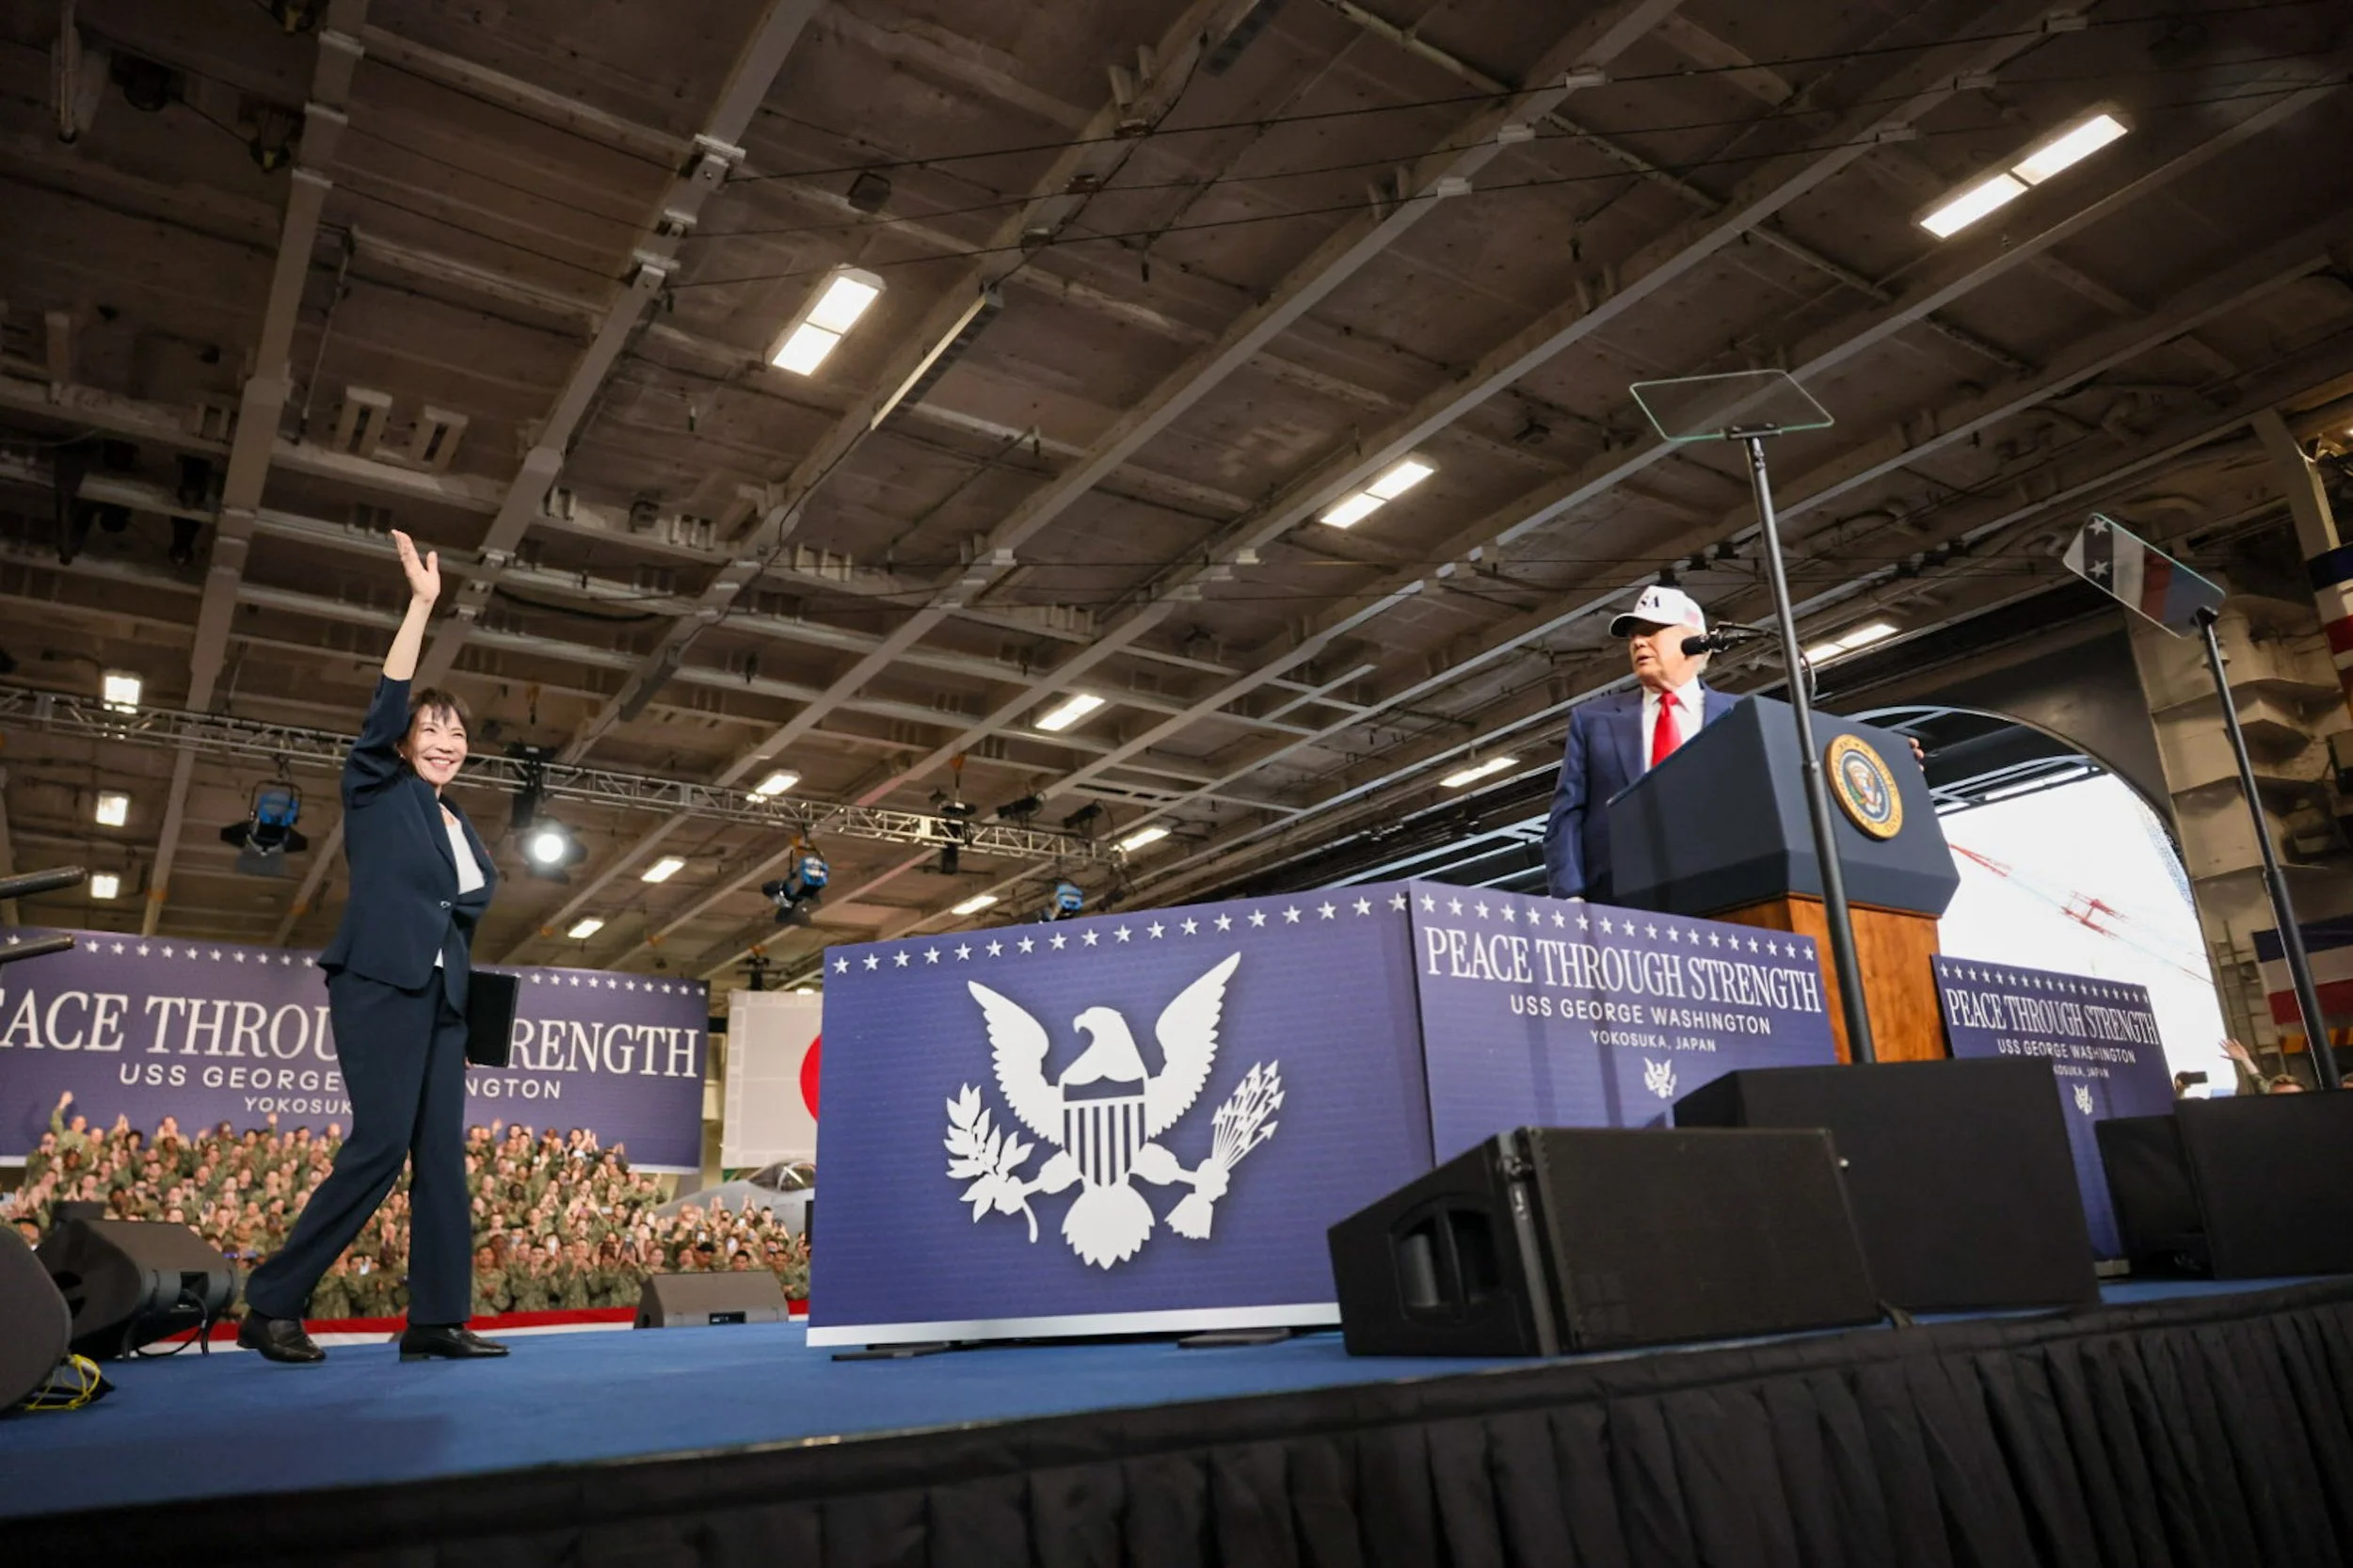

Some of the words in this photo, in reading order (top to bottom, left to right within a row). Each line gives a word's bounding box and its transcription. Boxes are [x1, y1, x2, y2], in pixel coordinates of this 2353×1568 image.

[1423, 926, 1533, 985] PEACE
[1535, 938, 1687, 999] THROUGH
[1688, 956, 1823, 1014] STRENGTH
[0, 987, 129, 1051] ACE
[144, 995, 339, 1062] THROU
[472, 1018, 699, 1079] RENGTH
[1510, 994, 1553, 1017] USS
[1560, 999, 1644, 1025] GEORGE
[1651, 1006, 1771, 1035] WASHINGTON
[1945, 987, 2008, 1030] PEACE
[2004, 995, 2087, 1037] THROUGH
[2084, 1004, 2160, 1046] STRENGTH
[1591, 1030, 1673, 1051] YOKOSUKA,
[1674, 1036, 1717, 1053] JAPAN
[1997, 1038, 2022, 1055] USS
[2023, 1040, 2069, 1059] GEORGE
[2070, 1044, 2137, 1064] WASHINGTON
[119, 1063, 187, 1087] USS
[202, 1065, 342, 1093] GEORGE
[465, 1077, 562, 1100] NGTON
[244, 1096, 353, 1115] YOKOSUK
